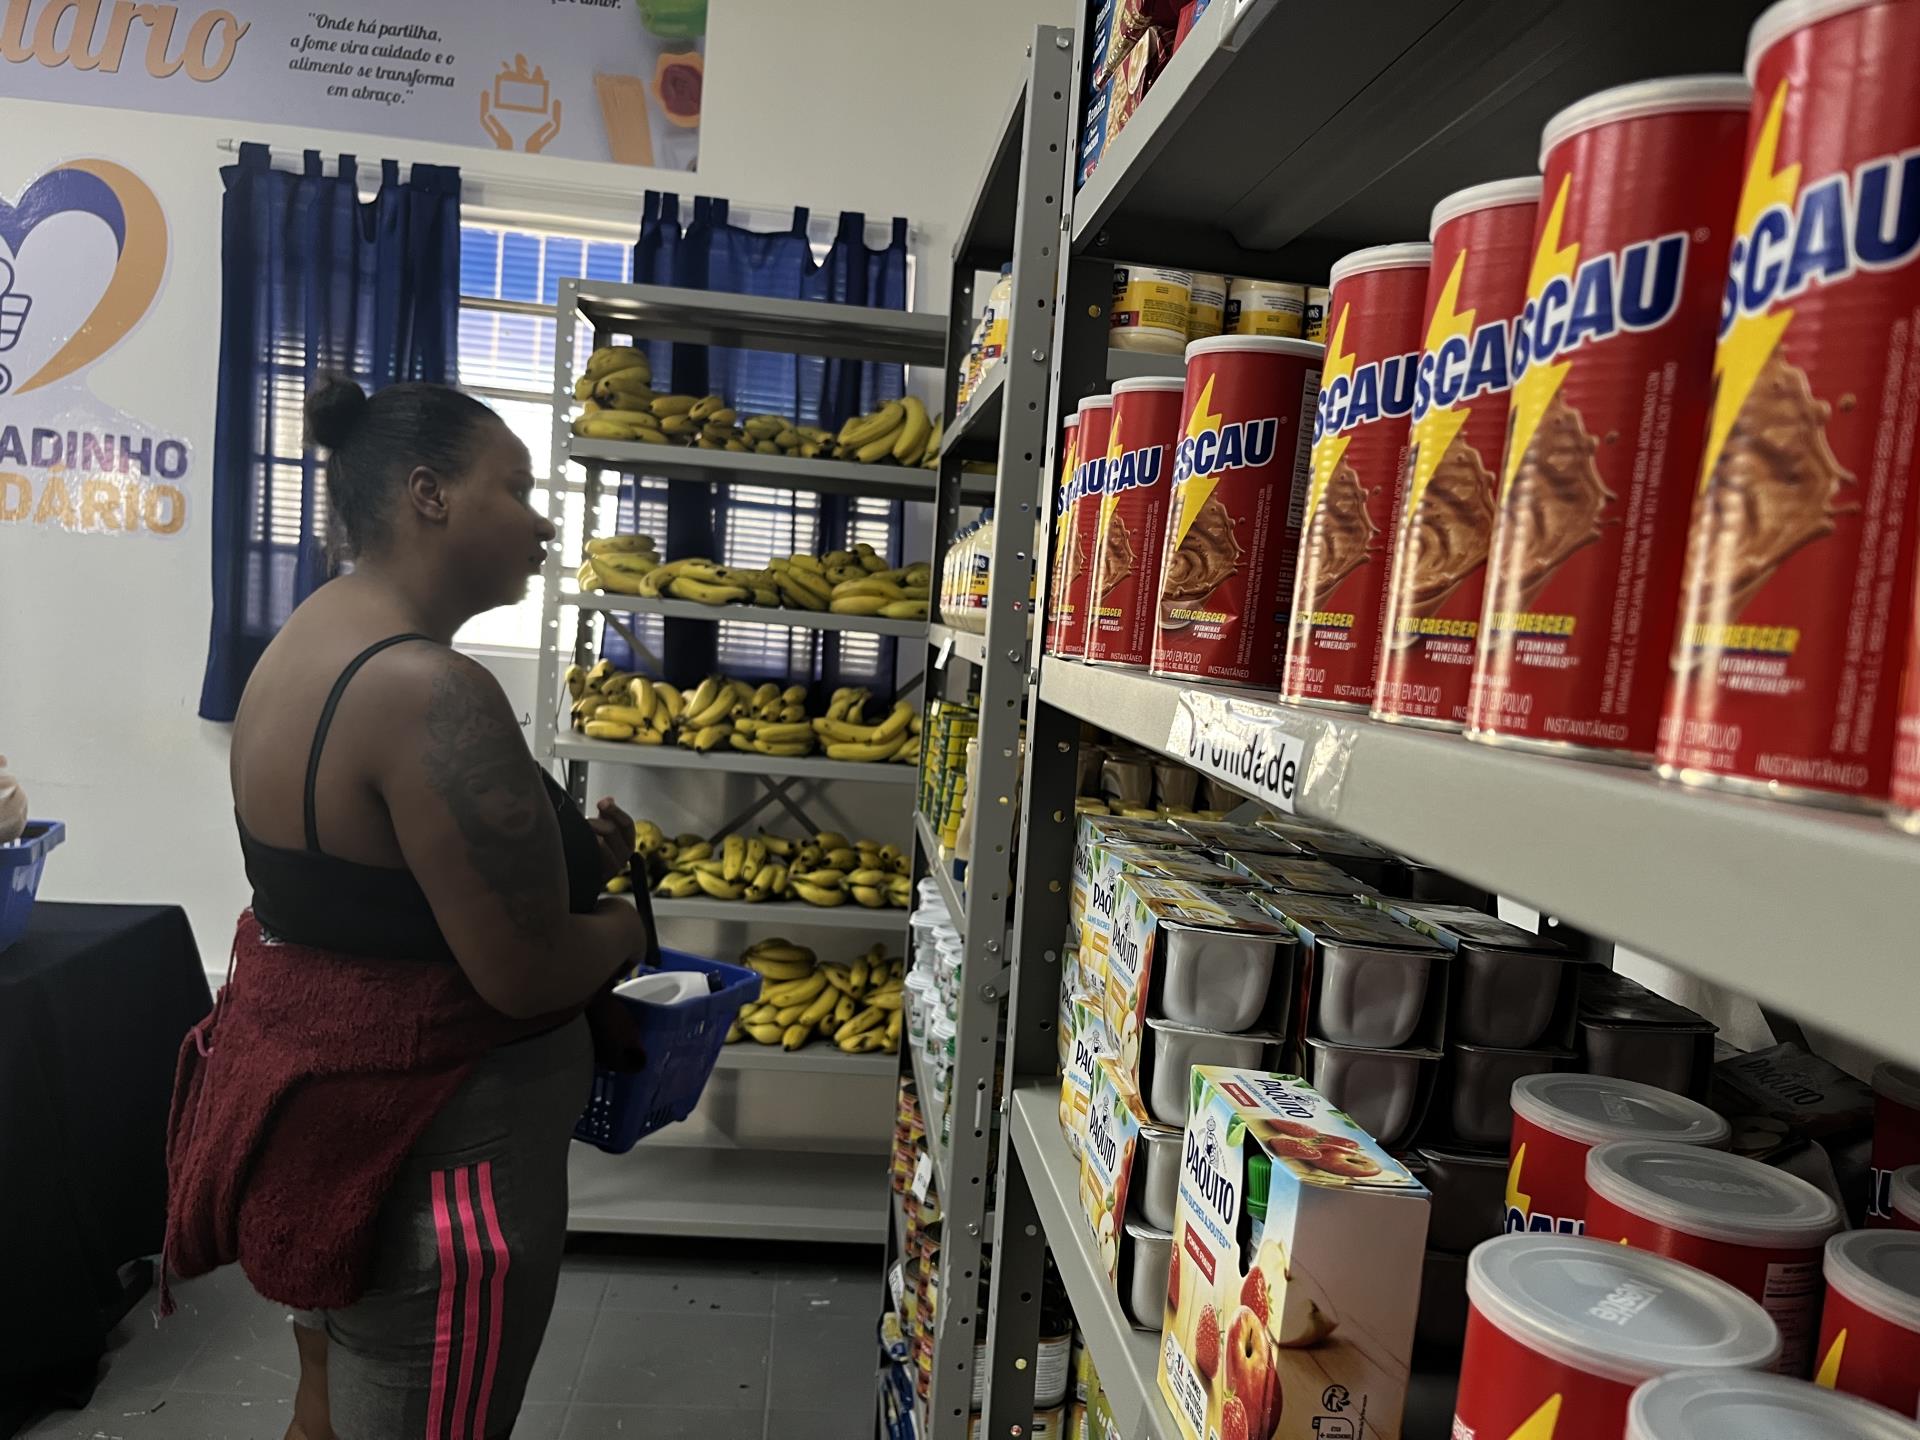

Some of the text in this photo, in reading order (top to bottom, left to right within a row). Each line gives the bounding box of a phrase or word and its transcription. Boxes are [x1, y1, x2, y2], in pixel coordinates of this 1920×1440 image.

[356, 19, 377, 34] há
[378, 23, 442, 43] partilha,
[290, 34, 455, 65] a fome vira cuidado e o
[288, 57, 455, 88] alimento se transforma
[326, 84, 349, 98] em
[0, 425, 188, 479] ADINHO
[0, 462, 186, 534] DÁRIO
[1169, 608, 1227, 623] FATOR CRESCER
[1312, 611, 1355, 627] CRESCER
[1194, 624, 1221, 633] VITAMINAS
[1315, 630, 1348, 640] VITAMINAS
[1420, 618, 1478, 638] CRESCER
[1425, 640, 1470, 654] VITAMINAS
[1516, 639, 1567, 655] VITAMINAS
[1183, 652, 1202, 664] POLVO
[1208, 665, 1249, 679] INSTANTÂNEO
[1305, 666, 1326, 683] POLVO
[1412, 684, 1441, 703] POLVO
[1502, 692, 1533, 715] POLVO
[1543, 716, 1629, 742] INSTANTÂNEO
[1092, 882, 1112, 919] PAQ
[1112, 918, 1138, 975] PAQUITO
[1254, 1079, 1314, 1119] PAQUITO
[1089, 1104, 1117, 1173] PAQUITO
[1185, 1129, 1235, 1225] PAQUITO
